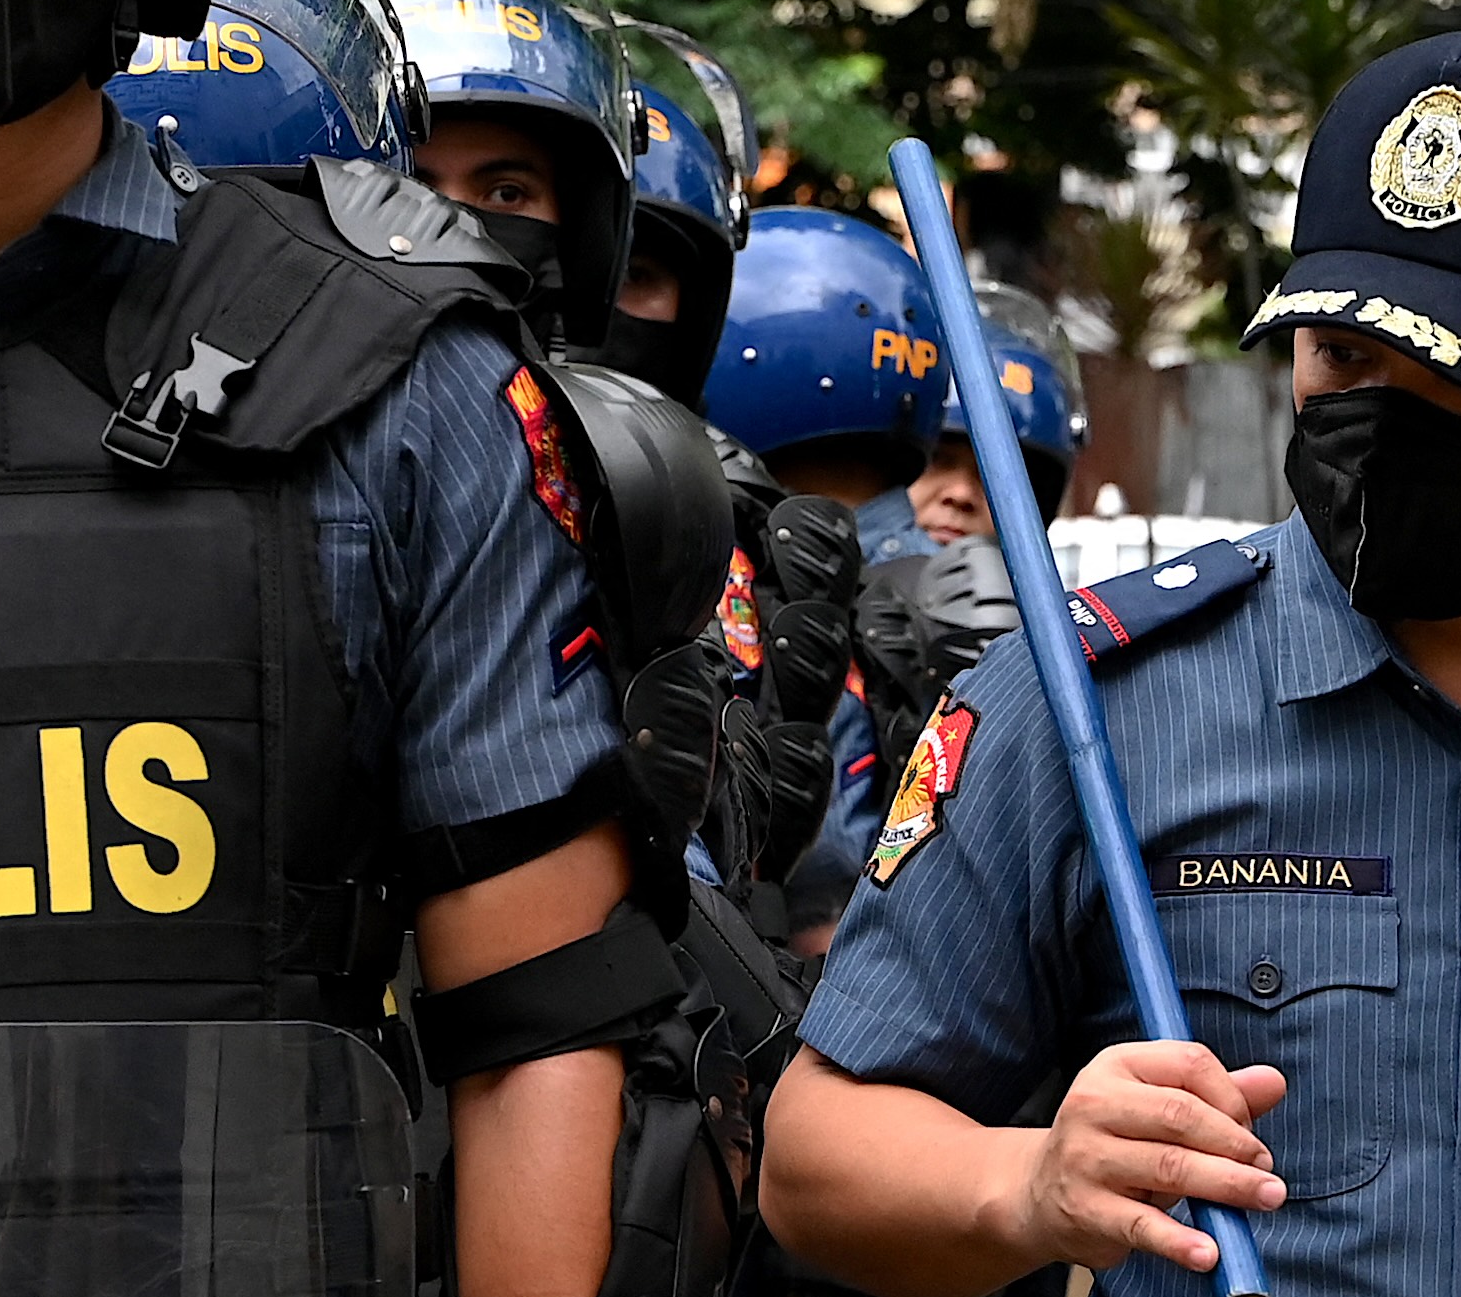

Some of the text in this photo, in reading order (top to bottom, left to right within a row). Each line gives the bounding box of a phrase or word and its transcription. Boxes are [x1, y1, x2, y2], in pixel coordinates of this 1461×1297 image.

[127, 21, 265, 75] ULIS
[1382, 192, 1452, 221] POLICE
[871, 328, 939, 380] PNP
[1067, 599, 1097, 626] PNP
[1178, 858, 1353, 888] BANANIA
